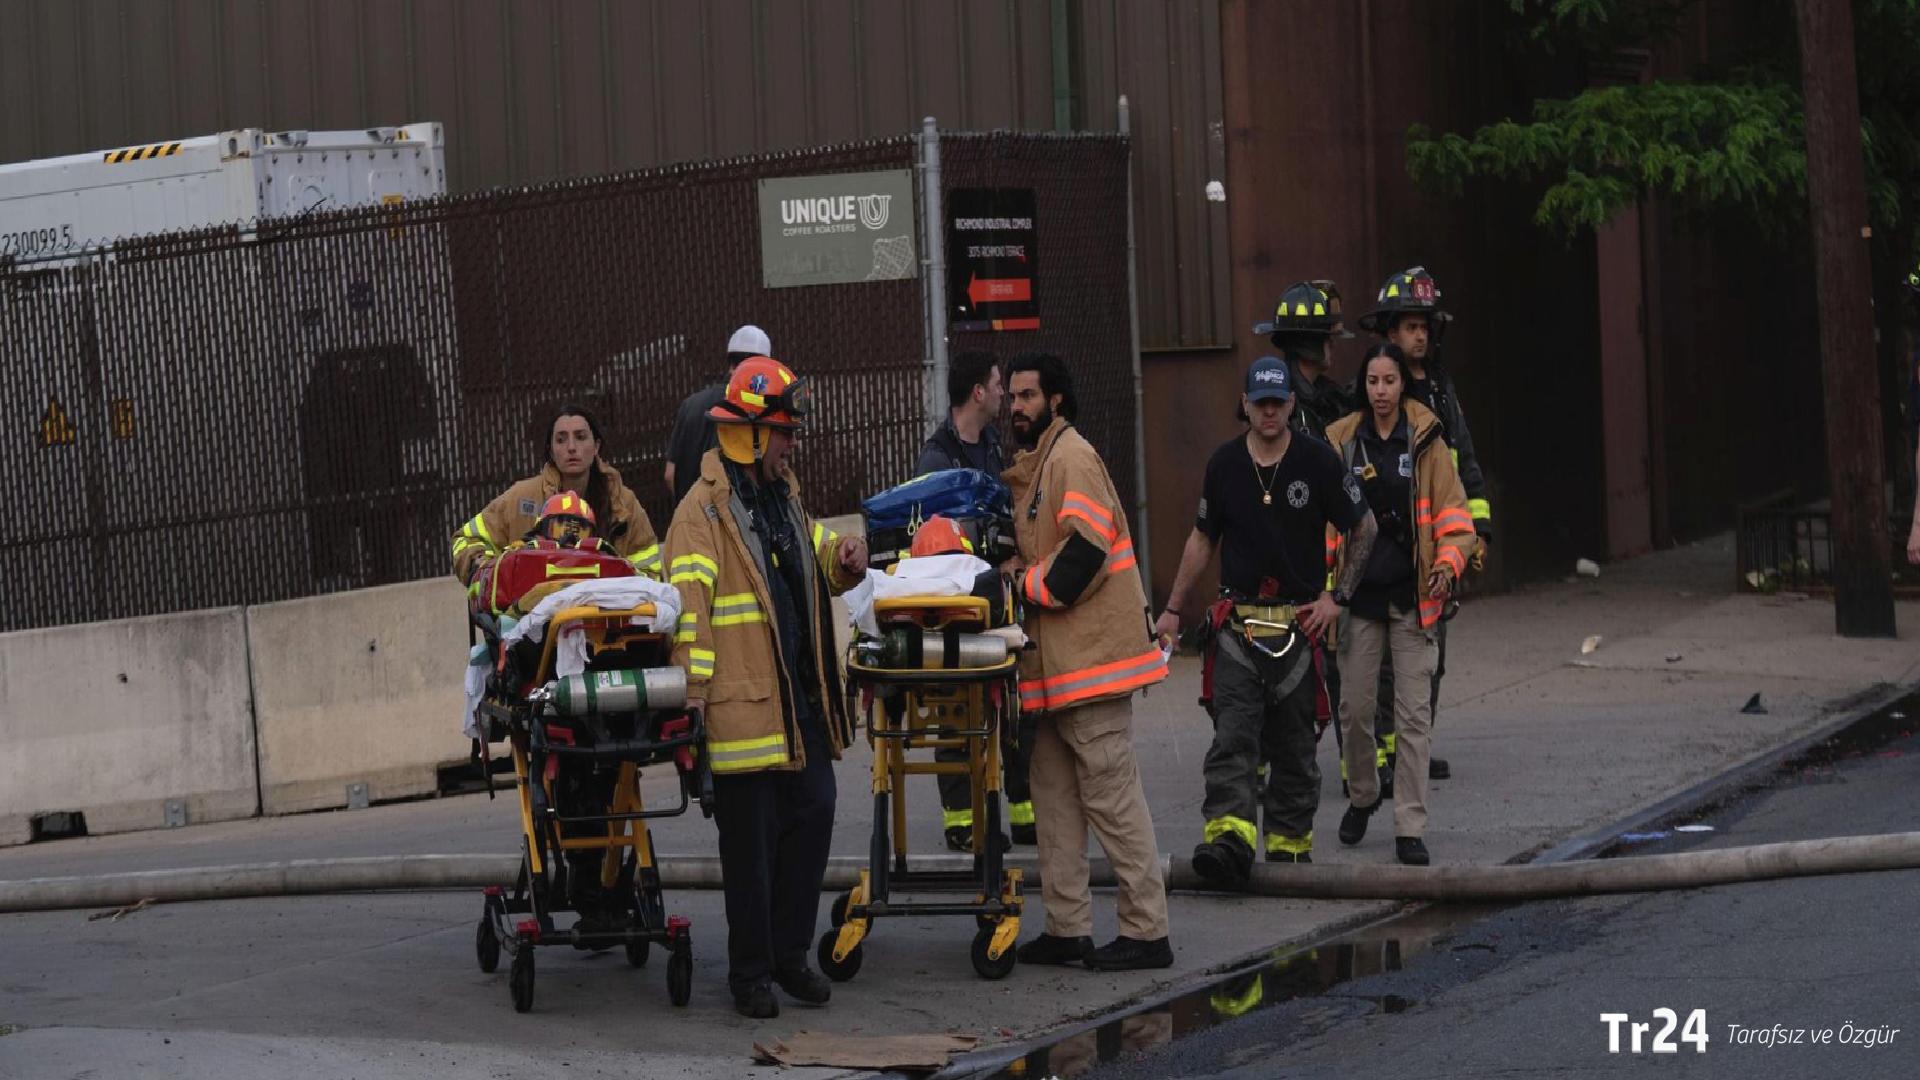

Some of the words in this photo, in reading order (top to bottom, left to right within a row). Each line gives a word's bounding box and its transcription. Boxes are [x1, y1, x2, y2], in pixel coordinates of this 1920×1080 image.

[781, 195, 856, 224] UNIQUE
[783, 226, 812, 237] COFFEE
[815, 223, 857, 234] ROASTERS
